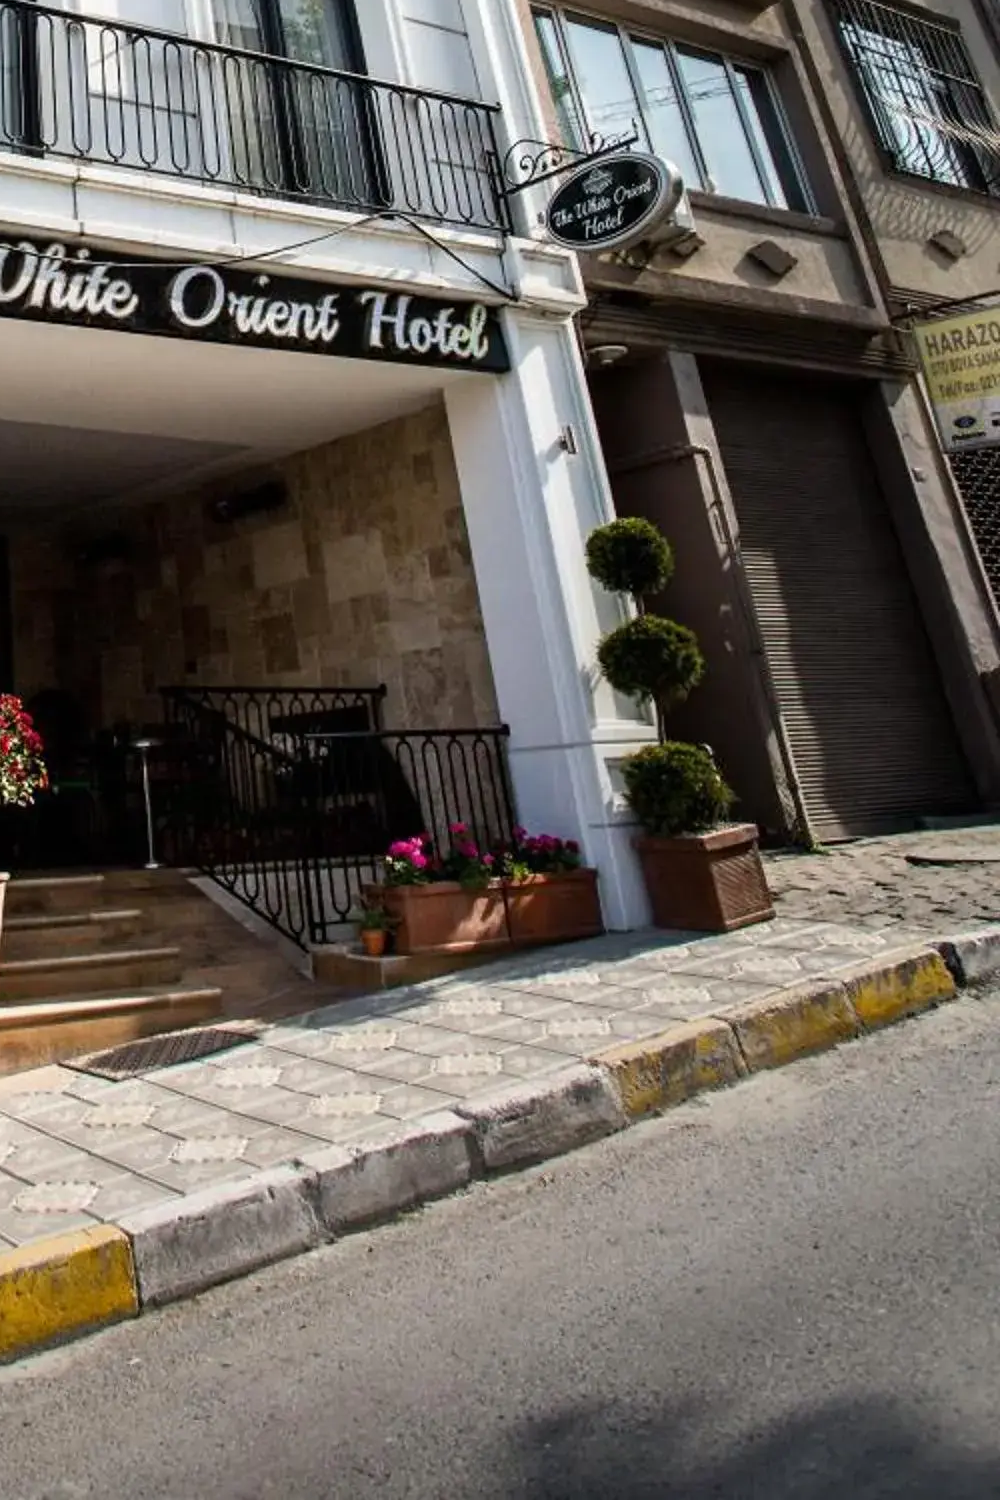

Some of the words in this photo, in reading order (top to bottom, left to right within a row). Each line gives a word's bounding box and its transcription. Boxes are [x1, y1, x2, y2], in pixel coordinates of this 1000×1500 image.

[582, 205, 624, 239] Hotel
[170, 266, 340, 342] Orient
[361, 291, 488, 359] Hotel
